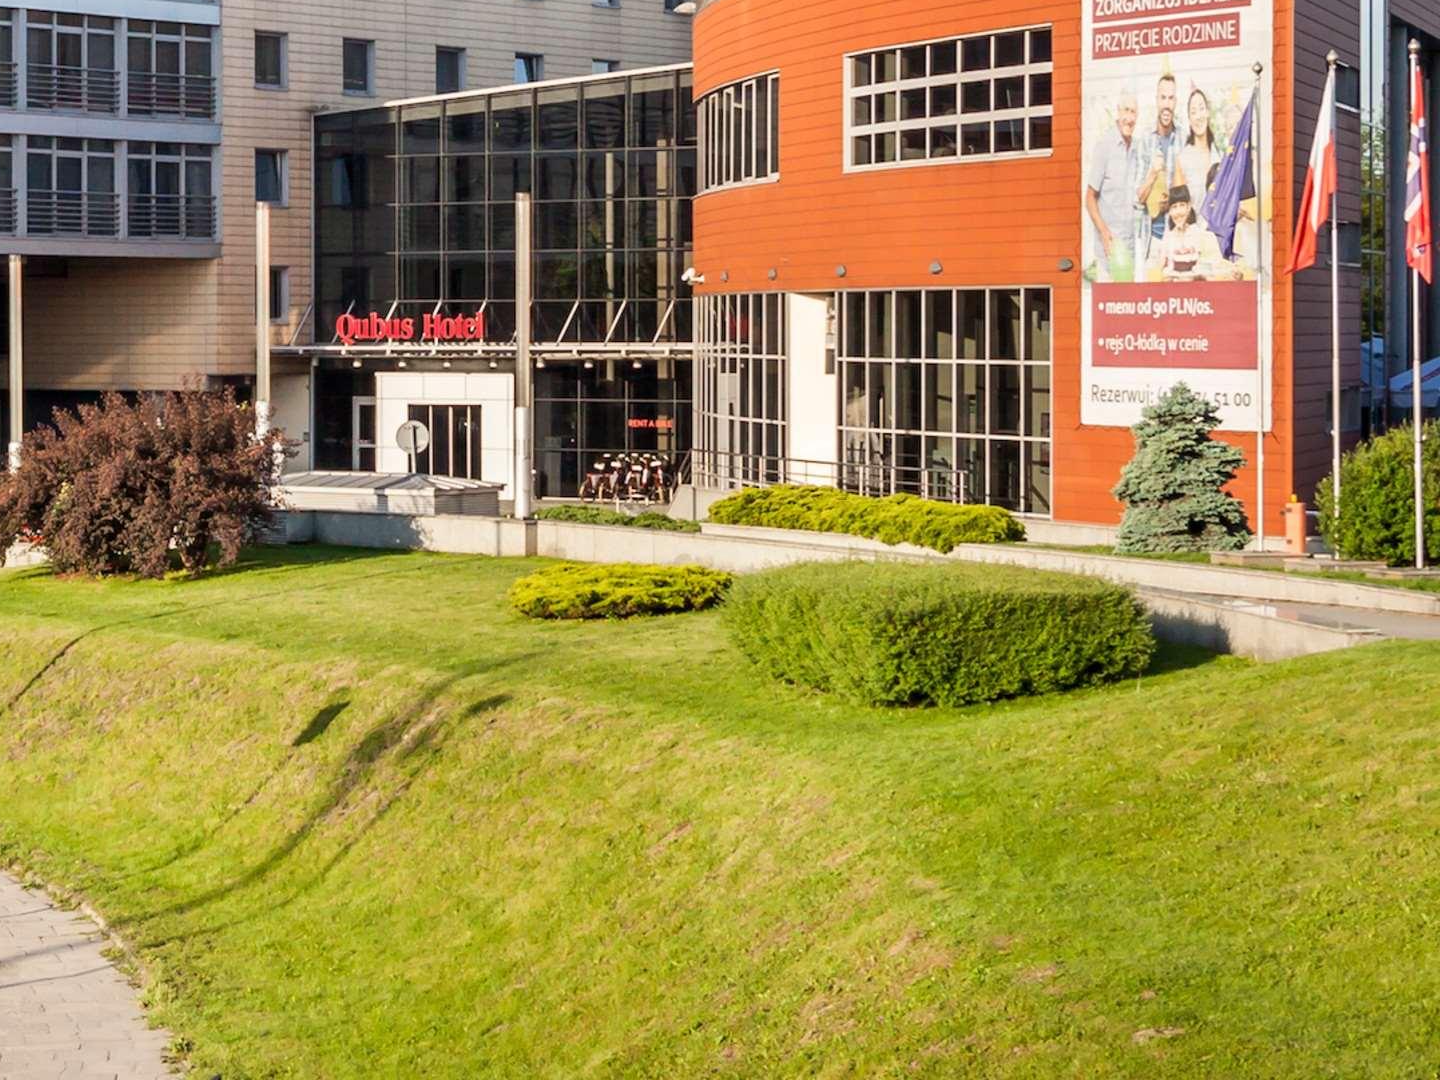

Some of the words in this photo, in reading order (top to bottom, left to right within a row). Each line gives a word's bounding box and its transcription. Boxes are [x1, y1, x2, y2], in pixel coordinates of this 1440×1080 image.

[1095, 27, 1159, 54] PRZYJĘCIE
[1162, 20, 1236, 46] RODZINNE
[1105, 302, 1135, 314] menu
[1137, 297, 1152, 314] od
[1169, 297, 1214, 317] PLN/os.
[336, 312, 413, 344] Qubus
[423, 312, 484, 339] Hotel
[1105, 335, 1124, 355] rejs
[1168, 338, 1178, 350] w
[1179, 335, 1209, 351] cenie
[1091, 384, 1154, 405] Rezerwuj:
[1234, 393, 1252, 407] 00
[628, 419, 648, 428] RENT
